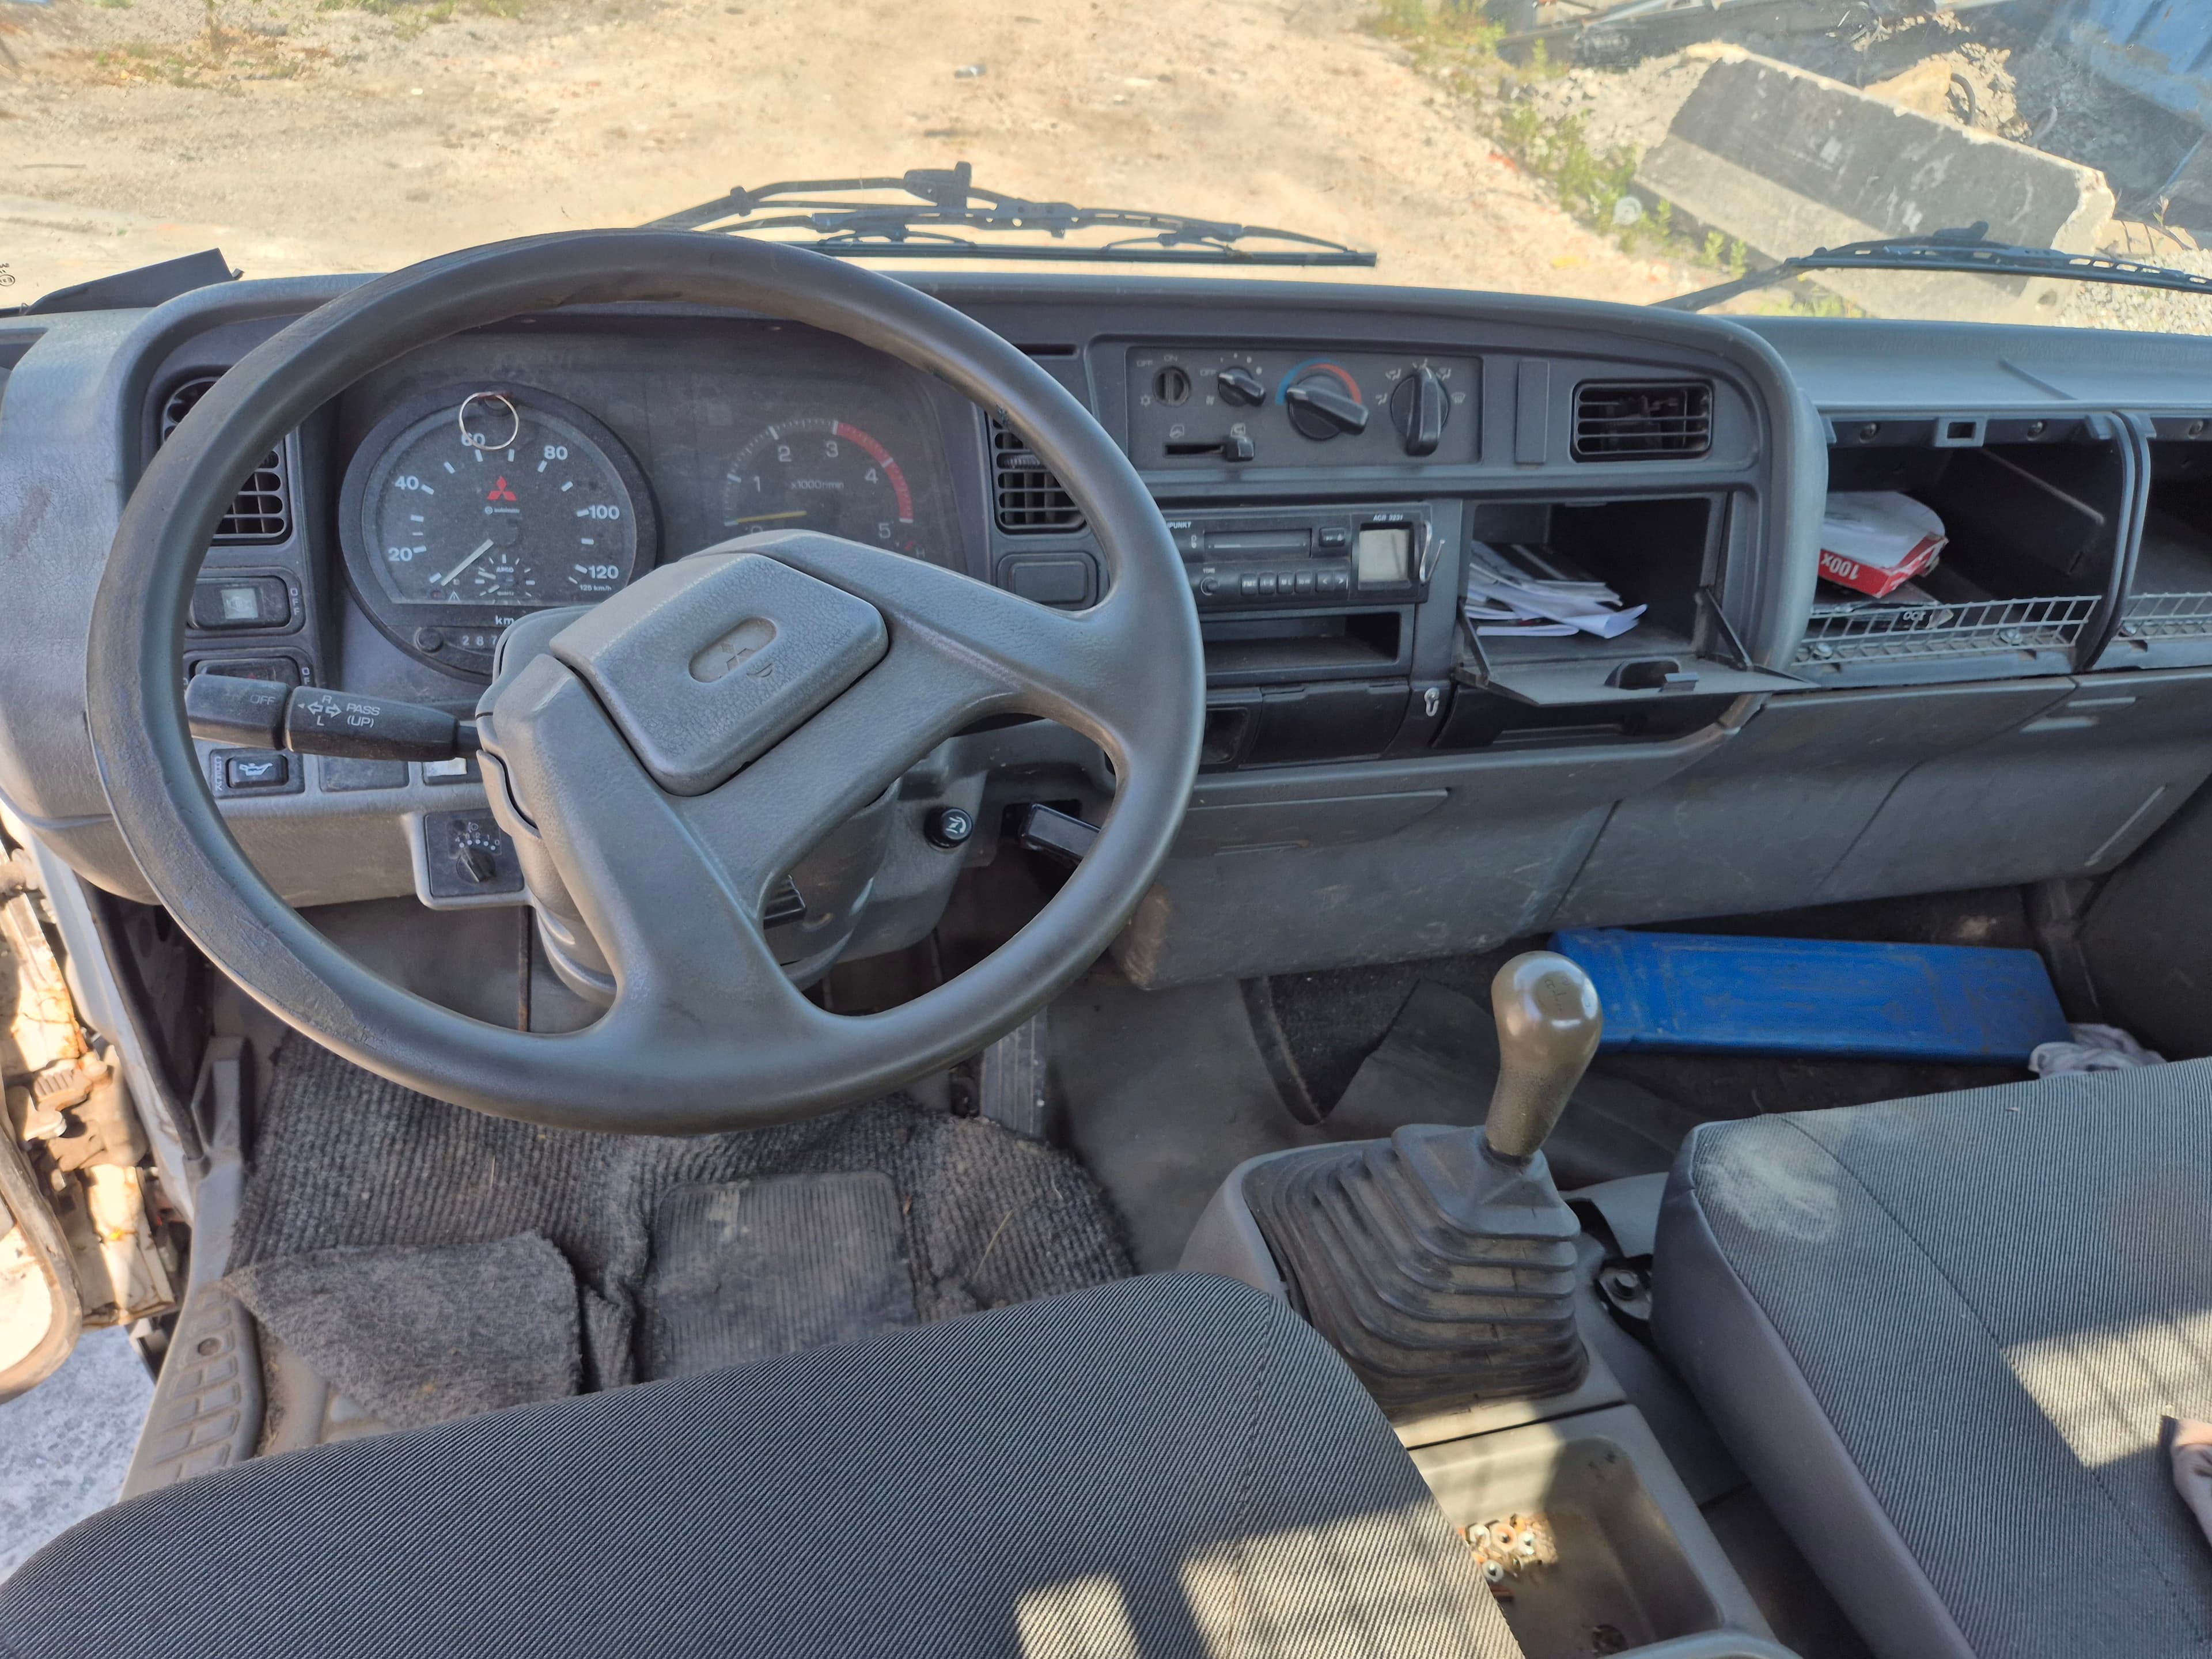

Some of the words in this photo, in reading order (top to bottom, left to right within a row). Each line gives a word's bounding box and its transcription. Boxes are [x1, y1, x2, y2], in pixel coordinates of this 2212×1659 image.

[461, 433, 486, 447] 60
[544, 445, 568, 460] 80
[778, 445, 792, 462] 2
[826, 441, 839, 457] 3
[395, 475, 419, 490] 40
[865, 468, 879, 484] 4
[753, 476, 761, 492] 1
[589, 505, 620, 520] 100
[878, 522, 891, 539] 5
[388, 547, 413, 562] 20
[588, 565, 619, 579] 120
[1820, 553, 1860, 581] 100x
[290, 586, 301, 616] OFF
[495, 615, 514, 625] km
[301, 666, 310, 685] OF
[250, 695, 276, 706] OFF
[322, 695, 332, 704] R
[346, 703, 381, 716] PASS
[317, 717, 324, 726] L
[347, 716, 374, 728] (UP)
